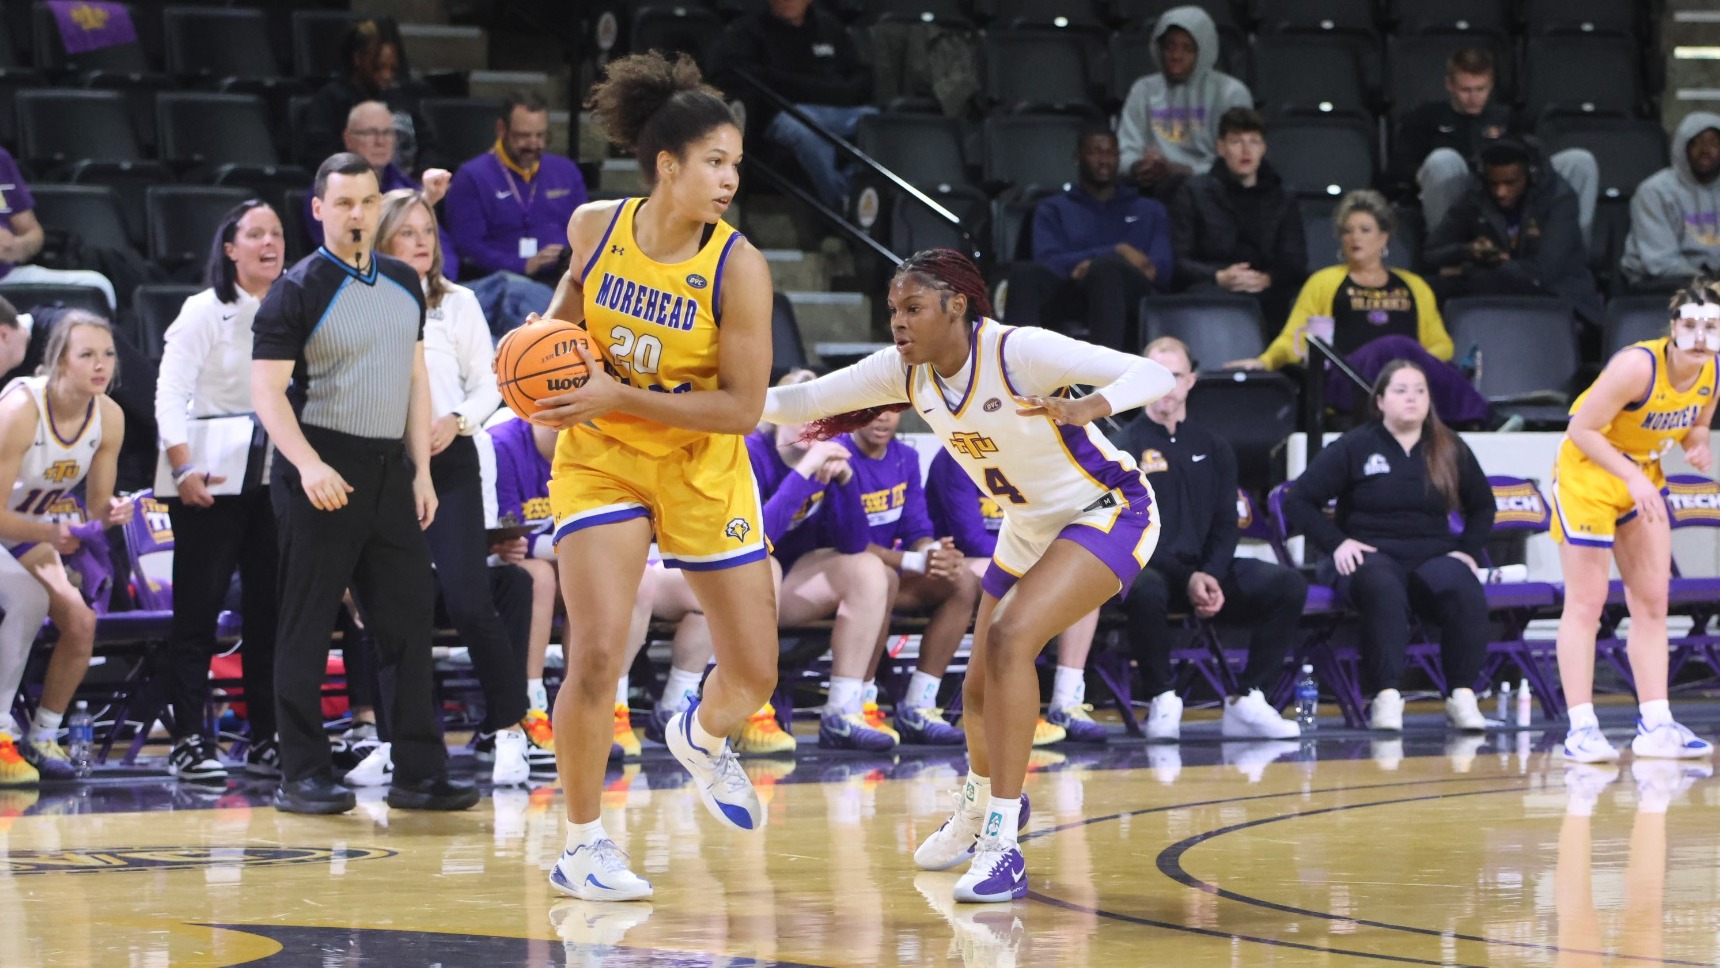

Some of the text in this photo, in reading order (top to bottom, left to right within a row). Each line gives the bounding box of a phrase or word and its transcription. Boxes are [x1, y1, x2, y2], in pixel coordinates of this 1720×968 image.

[595, 272, 698, 332] MOREHEAD
[609, 325, 663, 374] 20
[949, 432, 999, 459] TTU
[44, 459, 80, 483] TTU
[983, 467, 1029, 505] 4
[1495, 495, 1541, 513] ECH
